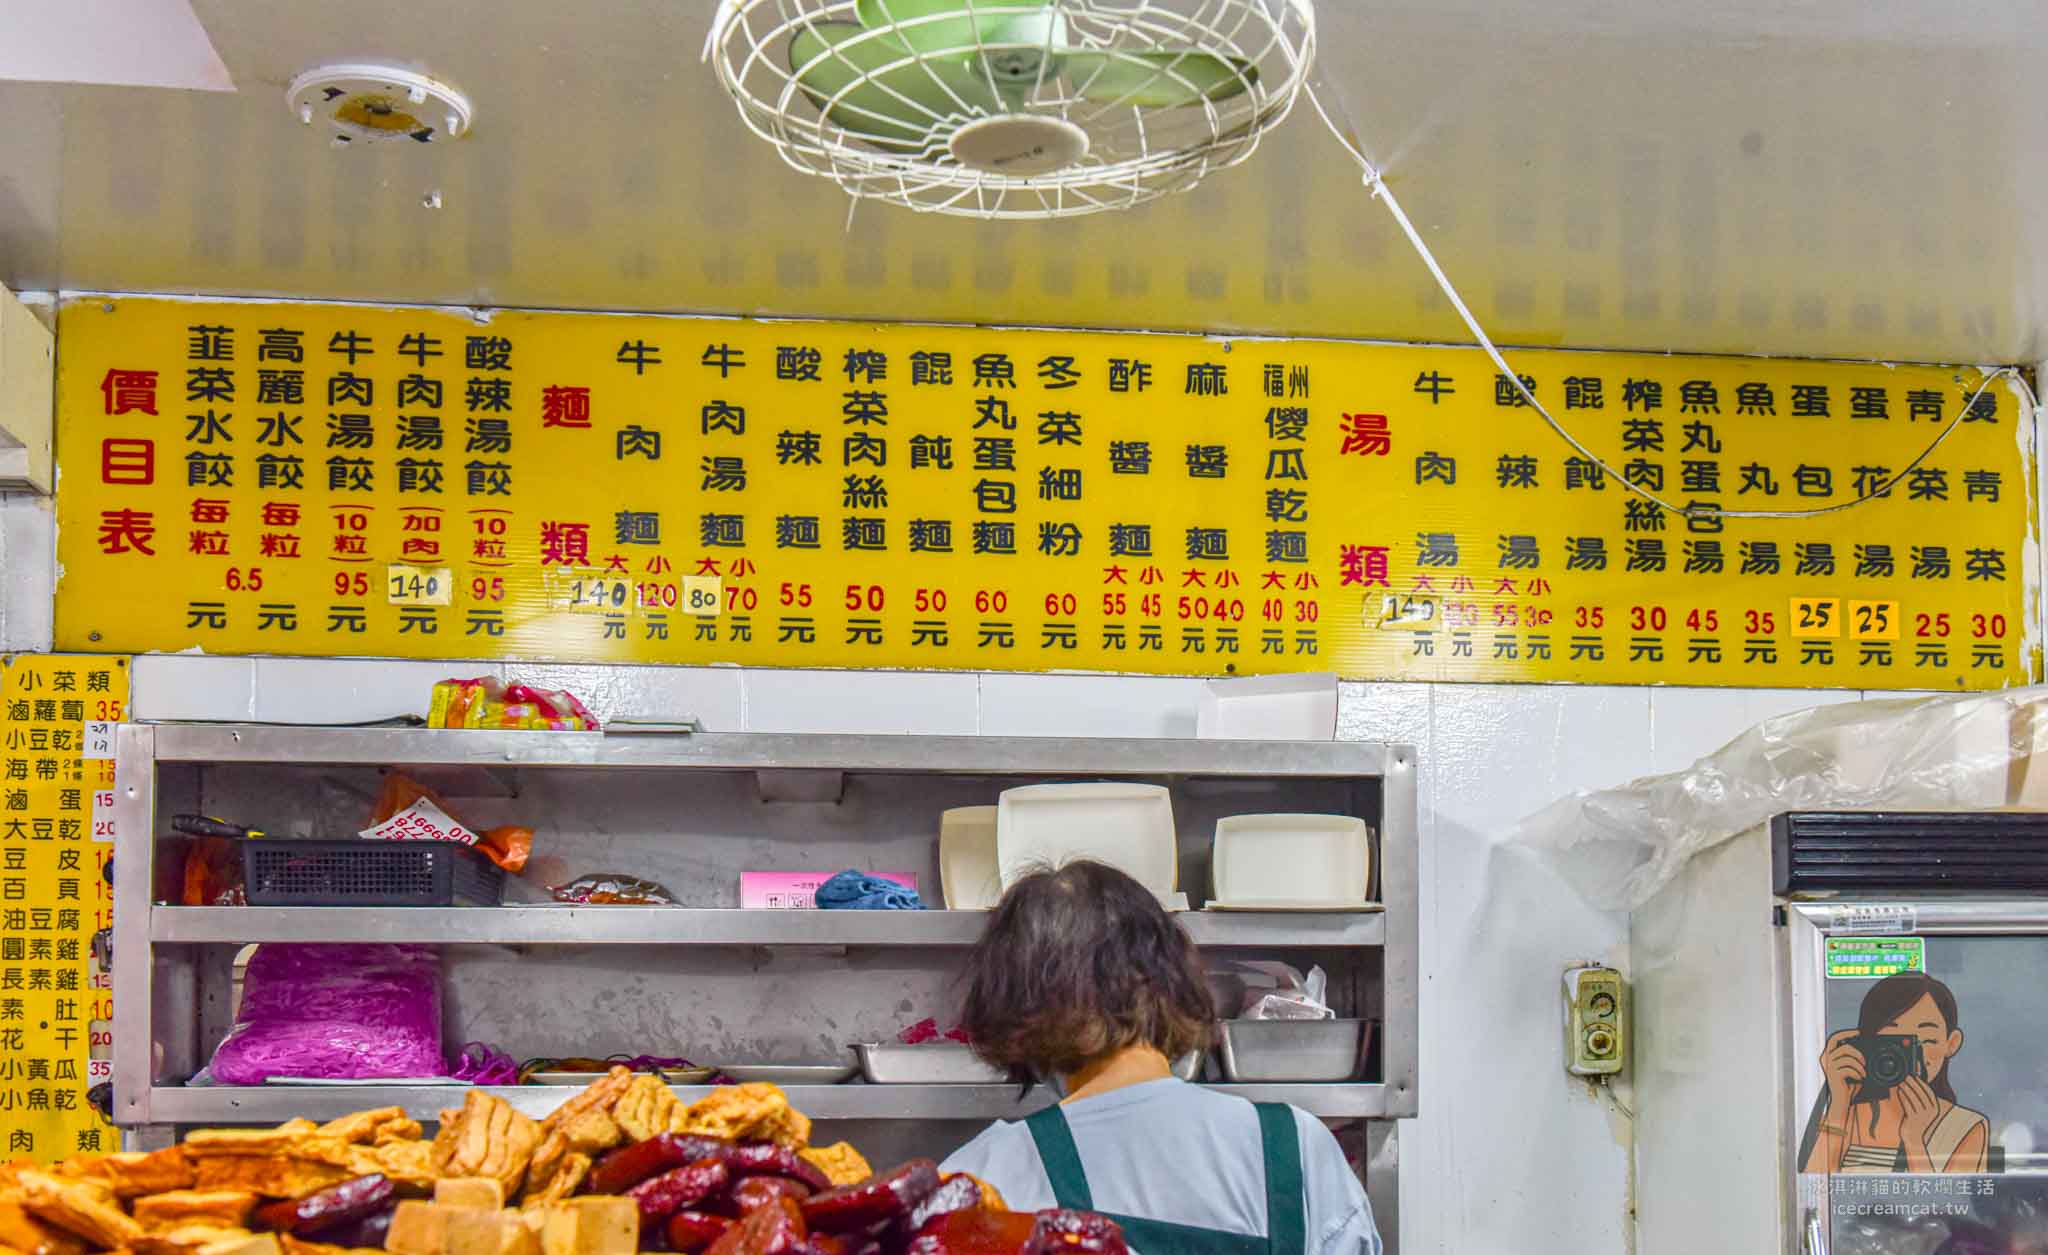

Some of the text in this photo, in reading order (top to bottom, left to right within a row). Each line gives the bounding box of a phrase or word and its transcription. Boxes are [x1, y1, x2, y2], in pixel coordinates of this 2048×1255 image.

[326, 330, 374, 491] 牛肉湯餃
[396, 332, 444, 493] 牛肉湯餃
[464, 336, 512, 495] 酸辣湯餃
[701, 344, 746, 547] 牛肉湯麵
[226, 328, 304, 630] 高麗水餃 每粒 6.5 元
[843, 348, 888, 644] 榨菜肉絲麵 50 元
[972, 354, 1016, 648] 魚丸蛋包麵 60 元
[1038, 356, 1082, 649] 冬菜細粉 60 元
[189, 498, 230, 555] 每粒
[1622, 378, 1666, 662] 榨菜肉絲湯 30 元
[1681, 380, 1724, 663] 魚丸蛋包湯 45 元
[335, 572, 368, 596] 95
[390, 574, 438, 599] 140
[472, 577, 504, 601] 95
[571, 581, 627, 607] 140
[604, 554, 628, 639] 大 元
[780, 582, 812, 608] 55
[1451, 576, 1474, 593] 小
[1528, 578, 1551, 596] 小
[636, 556, 677, 640] 小 120 元
[690, 589, 716, 608] 80
[696, 557, 720, 641] 大 元
[726, 558, 757, 642] 小 70 元
[915, 589, 946, 612] 50
[1102, 565, 1128, 649] 大 55 元
[1139, 566, 1163, 650] 小 45 元
[1178, 568, 1208, 653] 大 50 元
[1386, 597, 1434, 622] 140
[187, 602, 226, 629] 元
[328, 606, 366, 632] 元
[399, 608, 437, 634] 元
[466, 610, 504, 635] 元
[1213, 570, 1244, 653] 小 40 元
[1262, 571, 1286, 654] 大 40 元
[1295, 572, 1318, 654] 小 30 元
[1412, 573, 1435, 655] 大 元
[1493, 577, 1518, 658] 大 55 元
[1576, 607, 1604, 629] 35
[1745, 610, 1775, 634] 35
[1800, 603, 1832, 628] 25
[1856, 604, 1889, 633] 25
[778, 617, 815, 643] 元
[912, 621, 948, 646] 元
[1916, 613, 1950, 637] 25
[1972, 614, 2006, 638] 30
[1453, 633, 1472, 656] 元
[1527, 636, 1551, 659] 元
[1570, 636, 1604, 660] 元
[1744, 640, 1777, 664] 元
[1801, 641, 1833, 665] 元
[1859, 642, 1892, 666] 元
[1916, 643, 1947, 667] 元
[1972, 645, 2003, 668] 元
[19, 670, 110, 692] 小菜類
[96, 701, 121, 721] 35
[5, 728, 72, 750] 小豆乾
[5, 759, 57, 781] 海帶
[96, 793, 113, 806] 15
[4, 818, 81, 841] 大豆乾
[2, 908, 80, 931] 油豆腐
[1, 968, 79, 991] 長素雞
[91, 1032, 112, 1046] 20
[0, 1058, 110, 1081] 小黃瓜 35
[0, 1088, 77, 1111] 小魚乾
